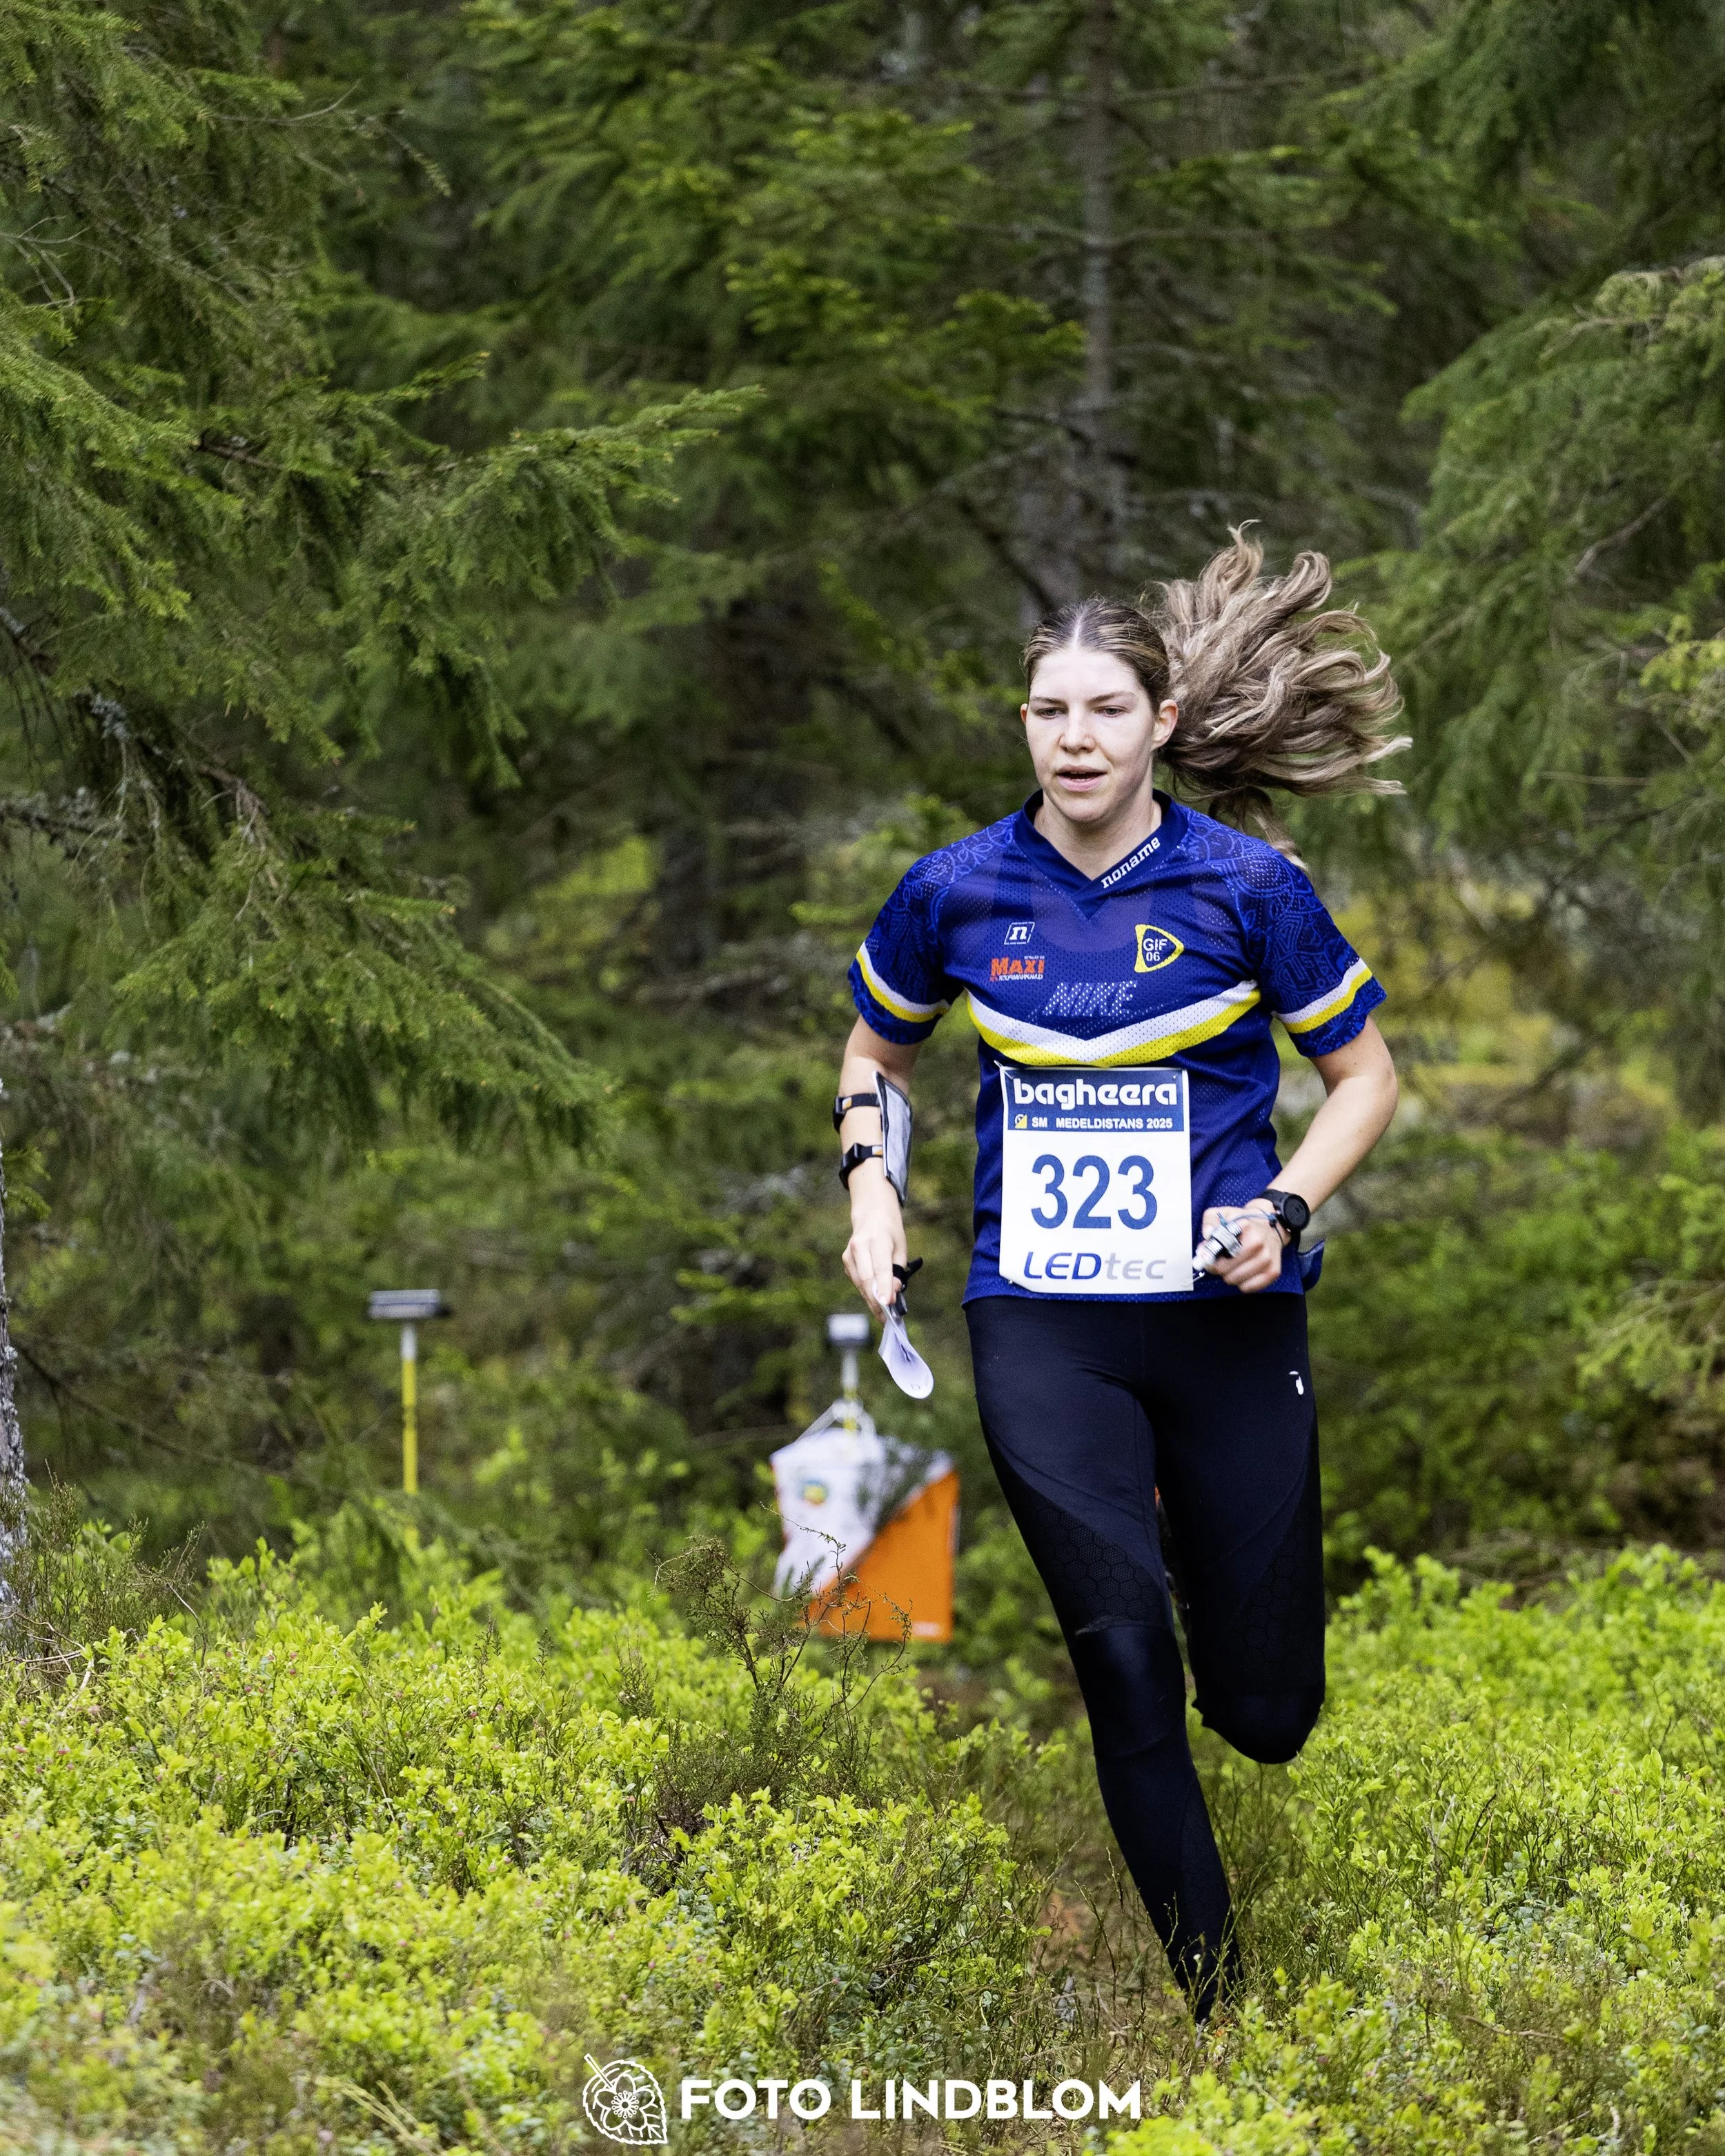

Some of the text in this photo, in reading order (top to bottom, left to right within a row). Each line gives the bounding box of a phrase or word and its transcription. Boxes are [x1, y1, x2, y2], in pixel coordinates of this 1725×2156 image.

[1101, 837, 1161, 889] noname
[1143, 938, 1167, 951] GIF
[1145, 951, 1161, 961] 06
[990, 956, 1045, 976] MAXI
[1042, 980, 1138, 1017] NIKE
[1013, 1078, 1177, 1110] bagheera
[1032, 1116, 1173, 1129] SM MEDELDISTANS 2025
[1031, 1154, 1158, 1230] 323
[1023, 1252, 1167, 1280] LEDtec
